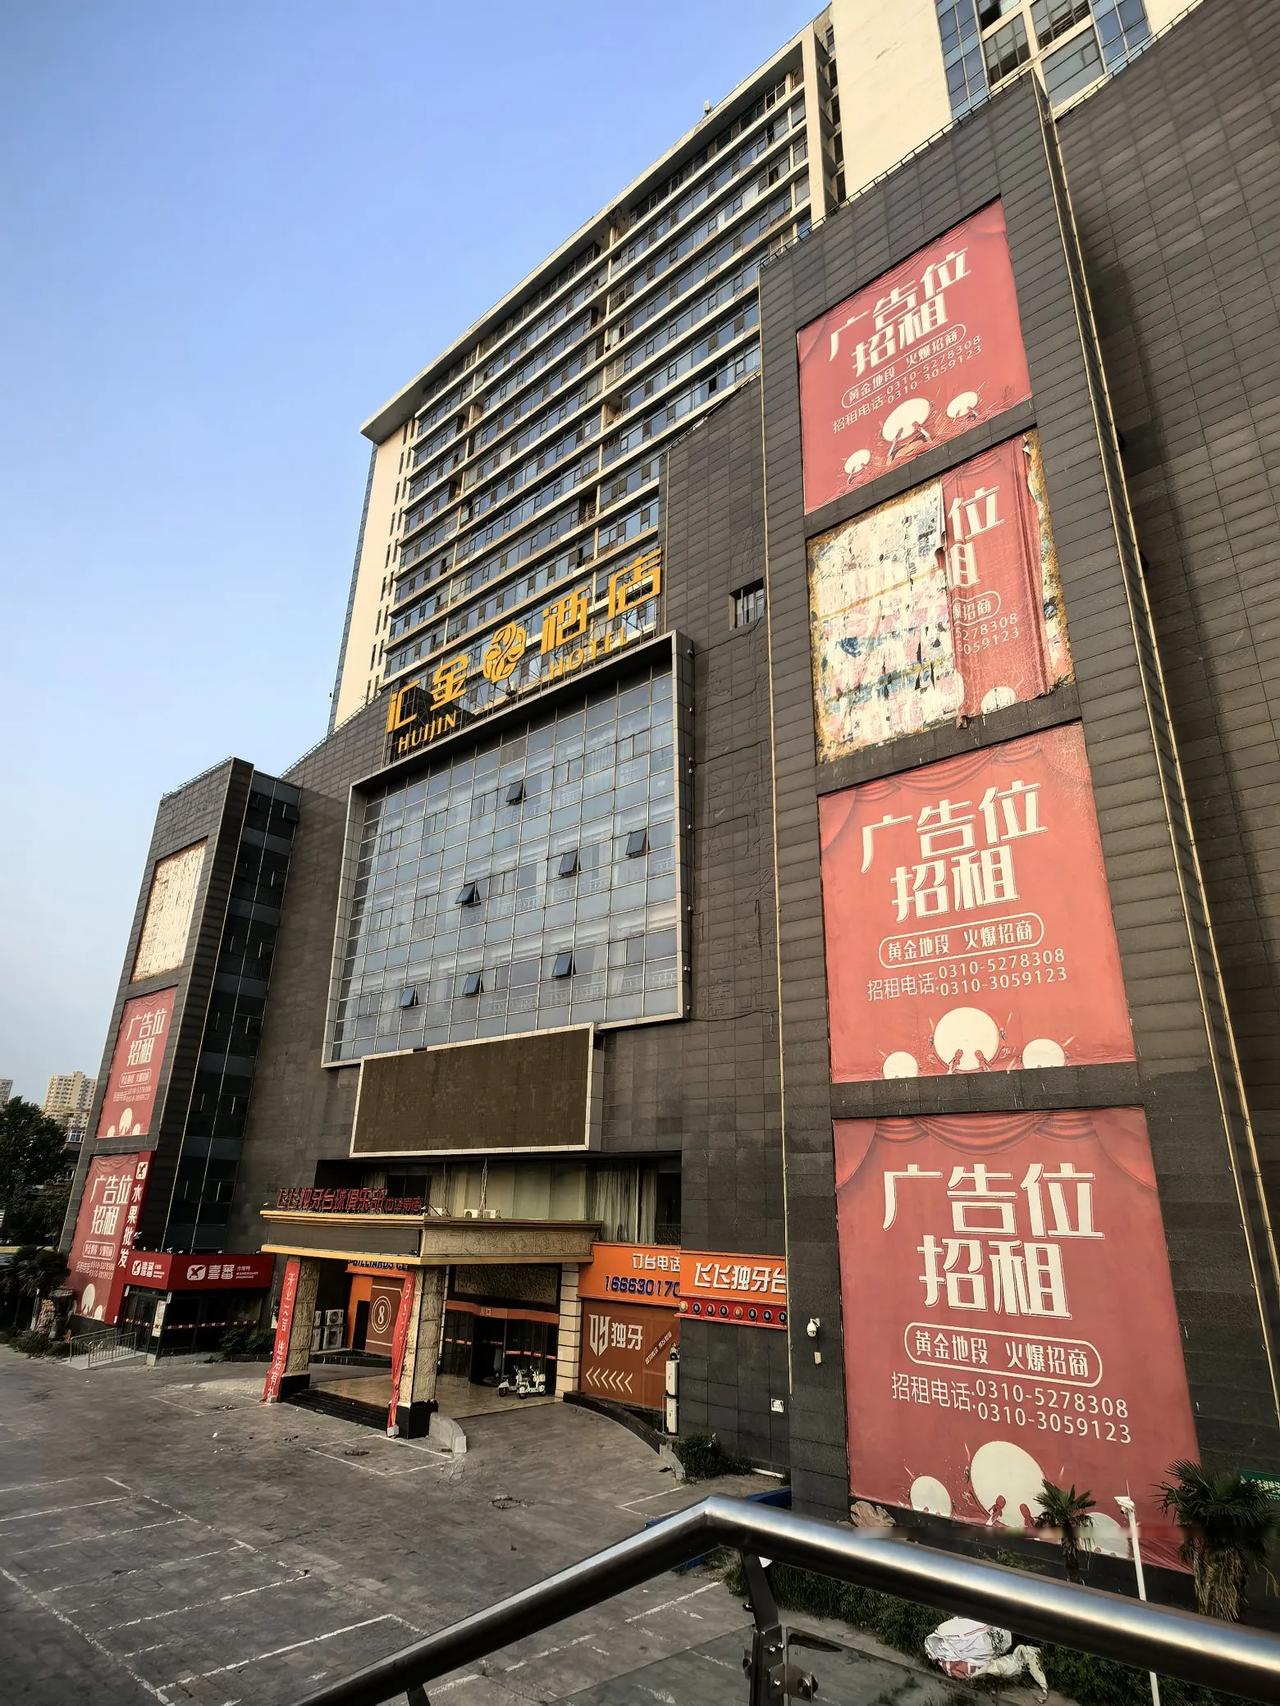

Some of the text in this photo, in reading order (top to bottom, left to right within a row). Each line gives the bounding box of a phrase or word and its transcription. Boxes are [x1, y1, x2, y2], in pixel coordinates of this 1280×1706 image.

[829, 247, 972, 362] 广告位
[851, 293, 949, 378] 招租
[847, 327, 959, 403] 黄金地段 火爆招商
[886, 335, 982, 394] 0310-5278308
[887, 345, 983, 405] 0310-3059123
[541, 547, 662, 656] 酒店
[549, 626, 626, 680] HOTEL
[386, 655, 469, 733] 汇金
[398, 709, 457, 753] HUIJIN
[860, 779, 1049, 874] 广告位
[890, 844, 1020, 922] 招租
[887, 919, 1033, 962] 黄金地段 火爆招商
[939, 948, 1066, 979] 0310-5278308
[940, 966, 1067, 997] 0310-3059123
[126, 1008, 167, 1041] 广告位
[126, 1037, 155, 1067] 招租
[90, 1175, 133, 1205] 广告位
[882, 1162, 1106, 1240] 广告位
[91, 1205, 121, 1236] 招租
[118, 1184, 143, 1268] 水果批发
[917, 1234, 1073, 1320] 招租
[611, 1322, 643, 1350] 独牙
[914, 1330, 1089, 1378] 黄金地段 火爆招商
[976, 1379, 1129, 1419] 0310-5278308
[977, 1401, 1132, 1444] 0310-3059123
